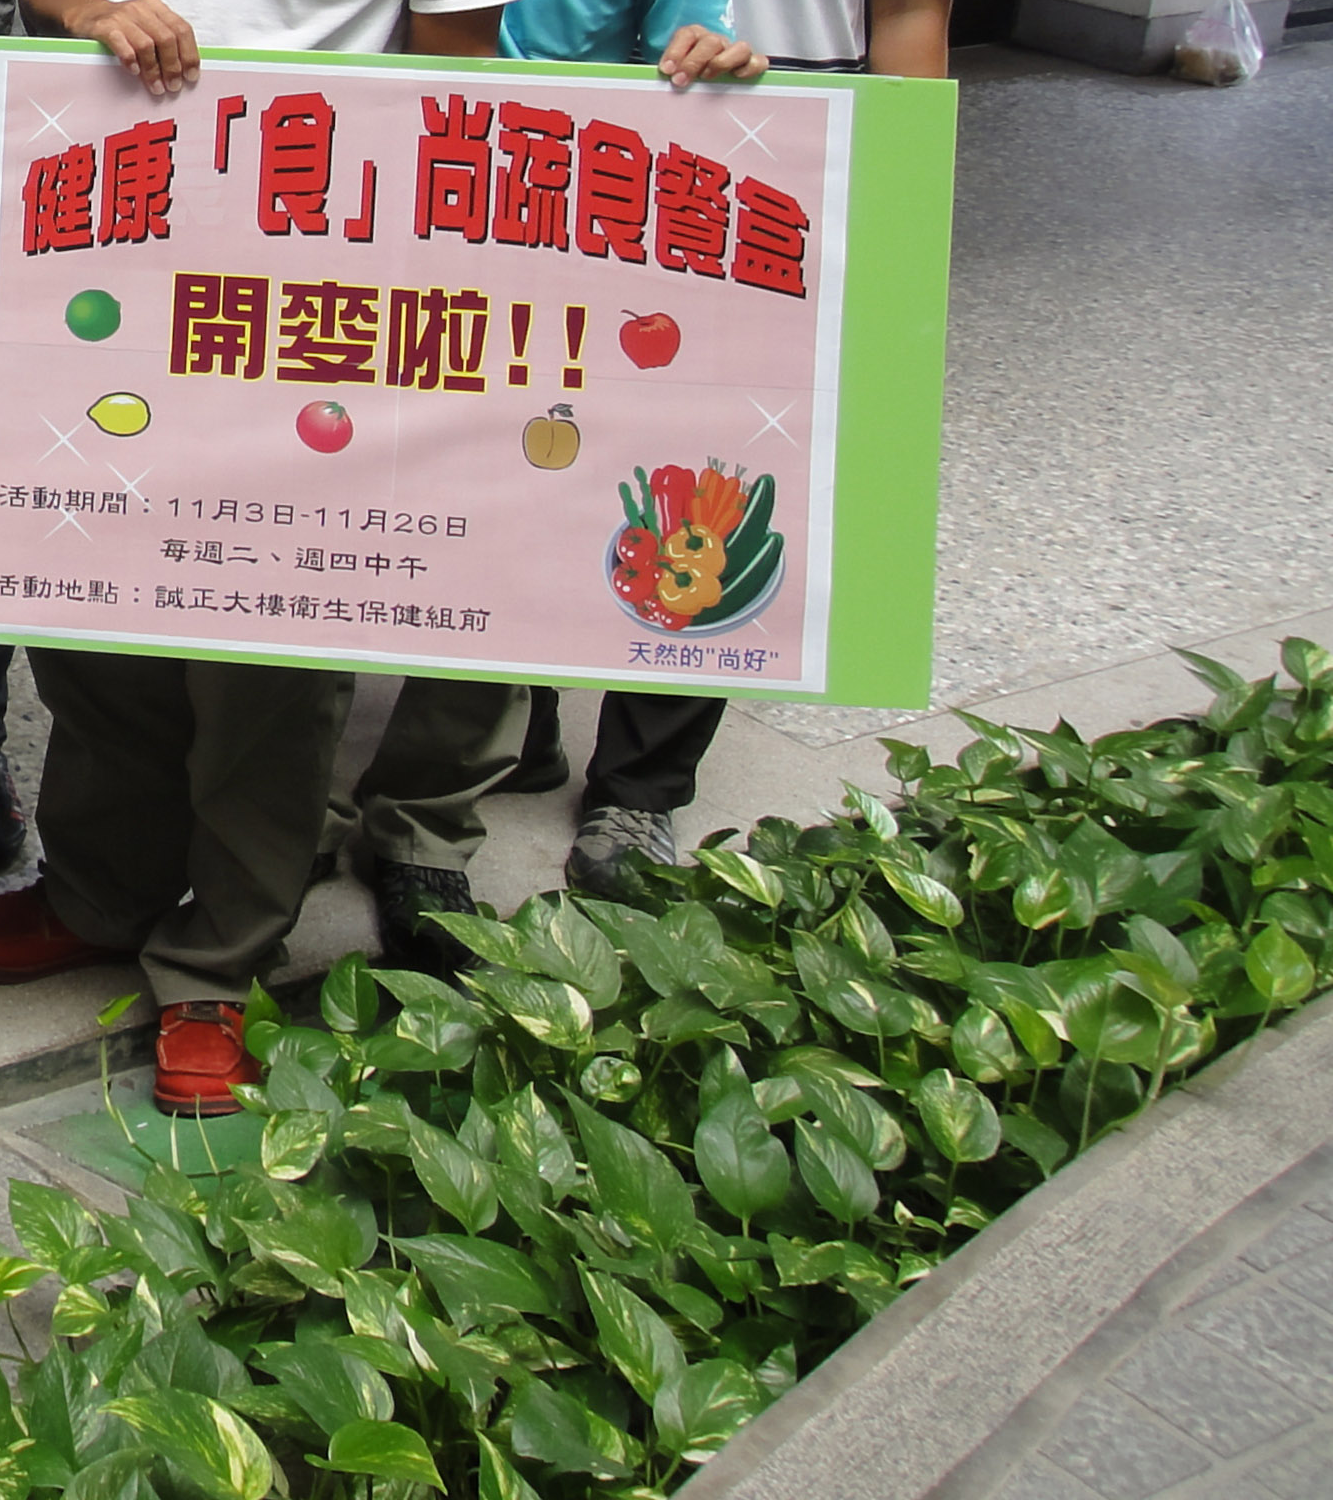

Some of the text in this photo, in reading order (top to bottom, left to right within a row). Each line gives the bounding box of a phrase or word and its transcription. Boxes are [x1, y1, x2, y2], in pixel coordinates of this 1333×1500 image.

[20, 90, 813, 299] 健康「食」尚蔬食餐盒
[168, 270, 589, 395] 開麥啦!!
[158, 535, 430, 581] 每週二、週四中午
